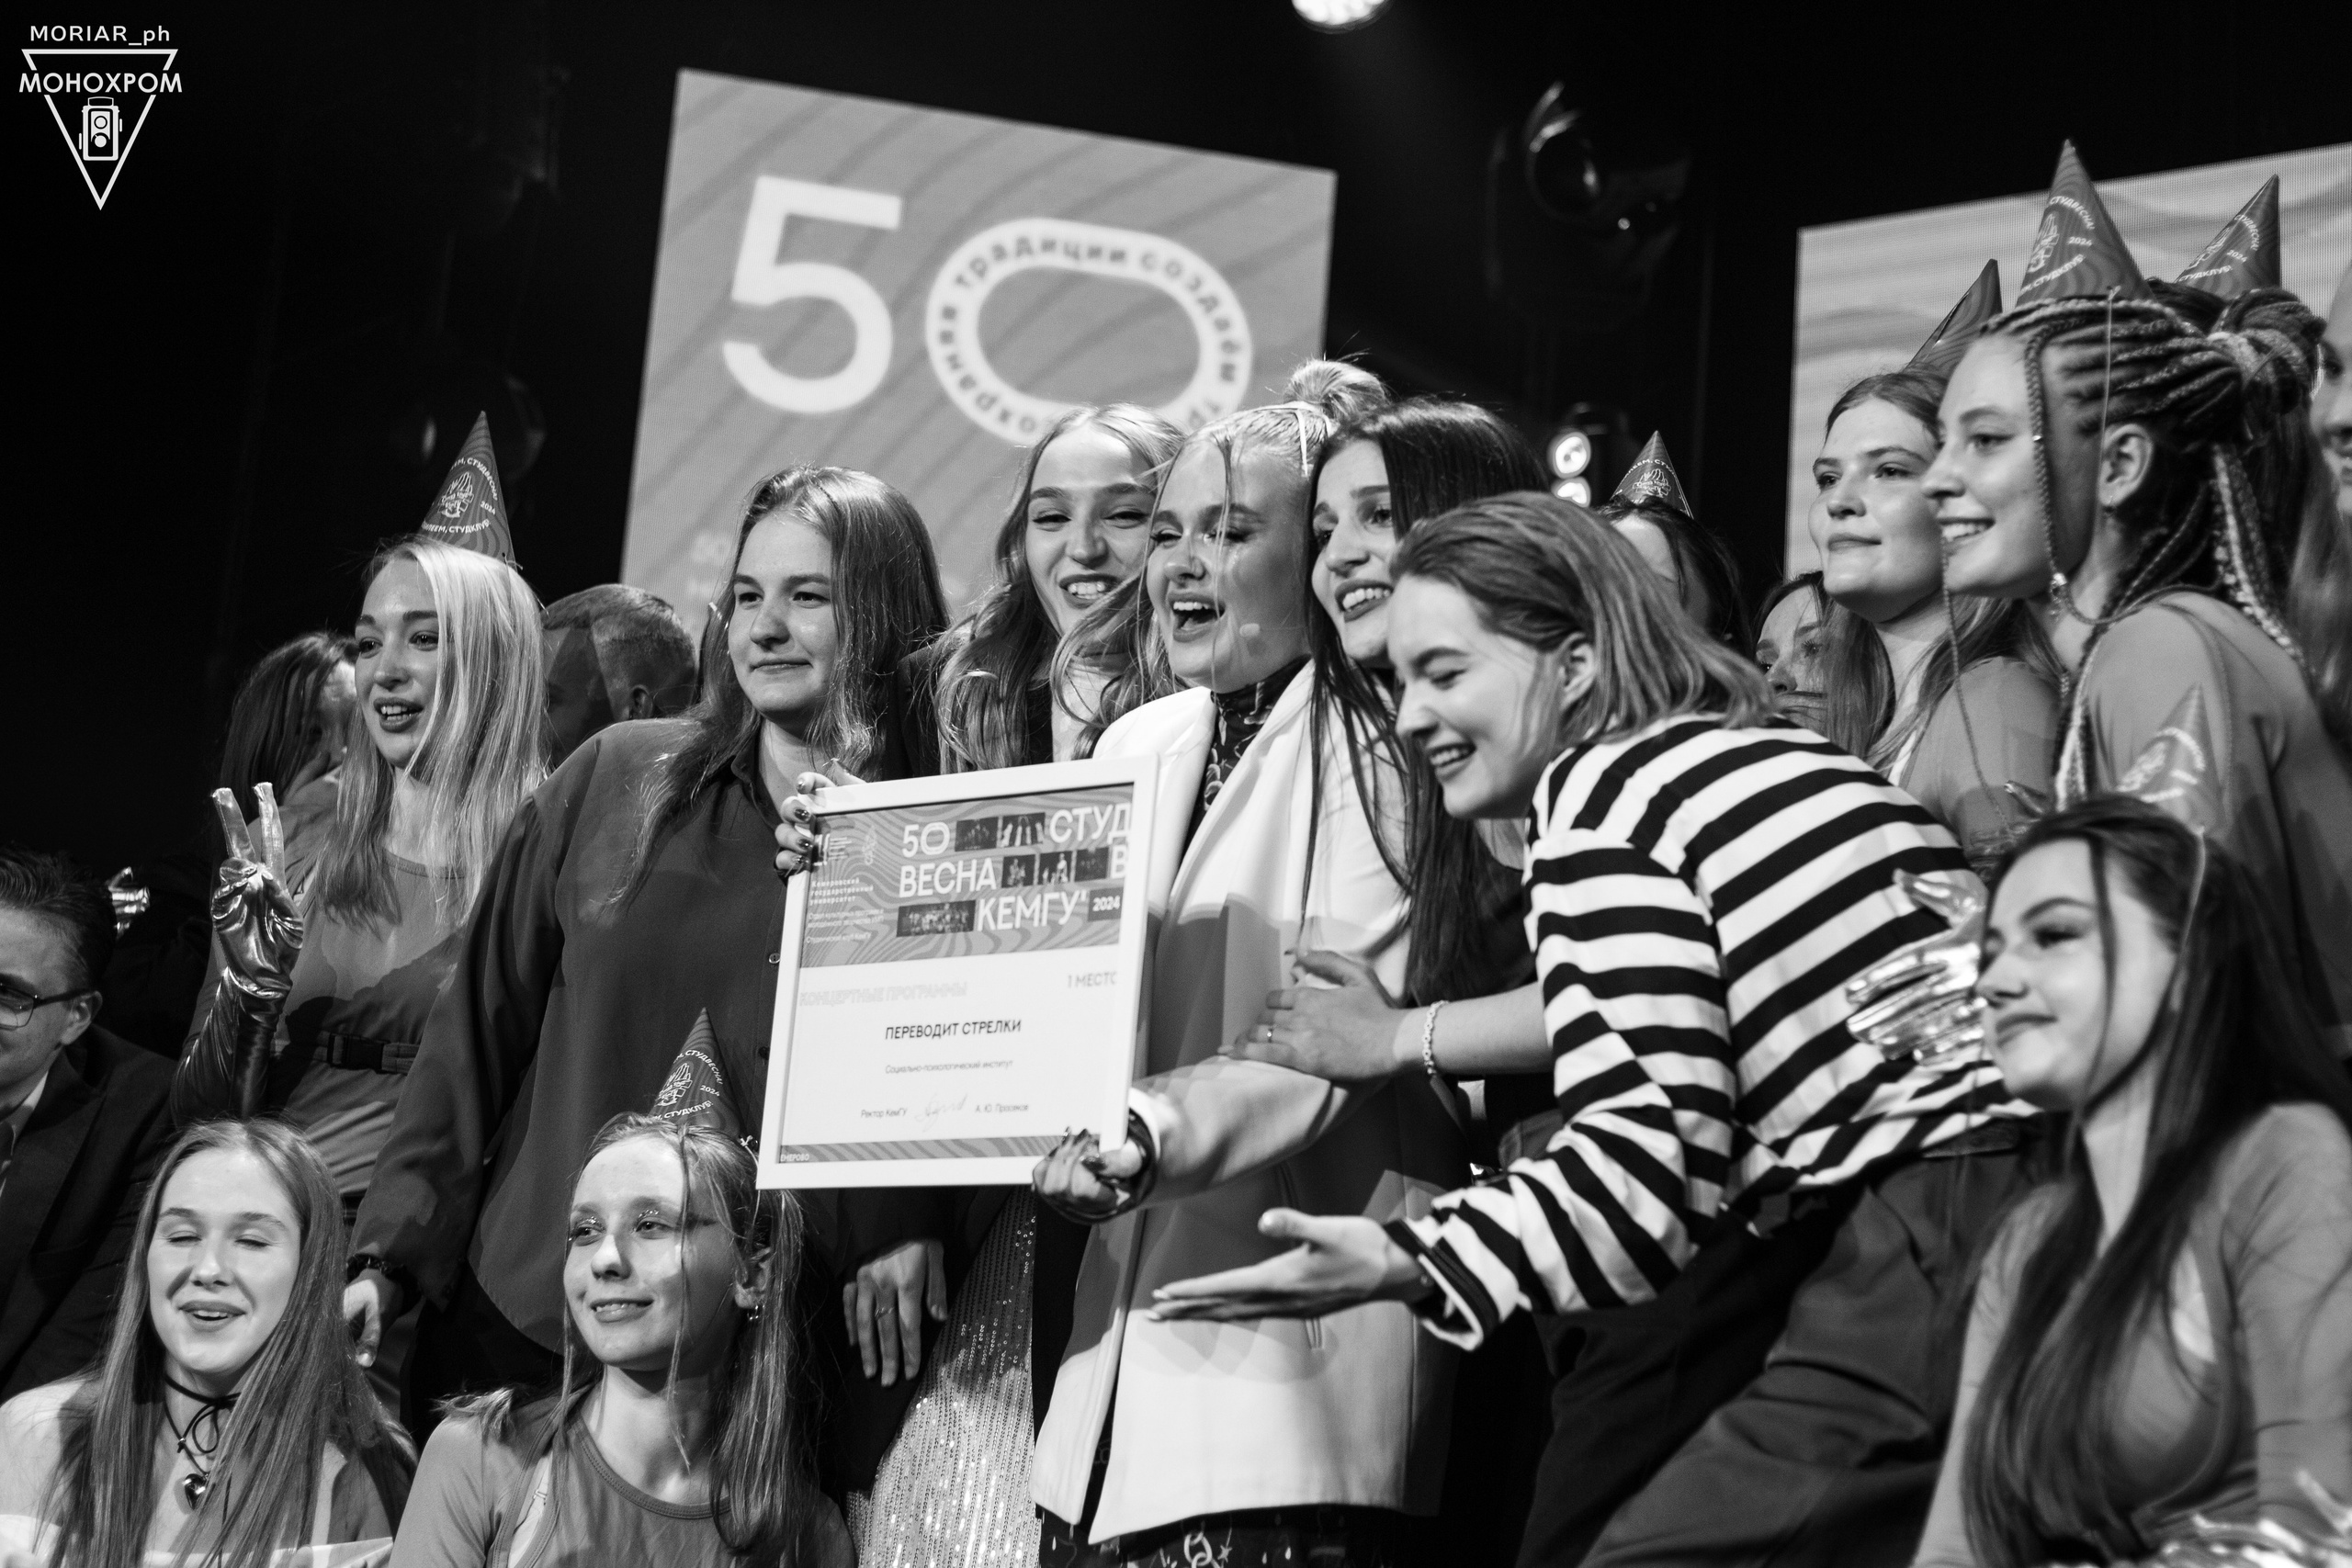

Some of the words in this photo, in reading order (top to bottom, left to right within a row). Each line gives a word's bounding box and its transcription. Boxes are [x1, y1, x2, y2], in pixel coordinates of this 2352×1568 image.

[2068, 236, 2092, 246] 2024
[956, 235, 1127, 290] традиции
[901, 822, 950, 858] 50
[1049, 803, 1131, 845] СТУД
[899, 858, 997, 898] ВЕСНА
[1110, 844, 1129, 879] В
[1092, 896, 1122, 912] 2024
[1067, 975, 1073, 987] 1
[799, 987, 884, 1008] КОНЦЕРТНЫЕ
[886, 982, 967, 1001] ПРОГРАММЫ
[885, 1021, 958, 1040] ПЕРЕВОДИТ
[962, 1019, 1023, 1035] СТРЕЛКИ
[699, 1085, 720, 1097] 2024
[780, 1153, 809, 1163] ЕМЕРОВО
